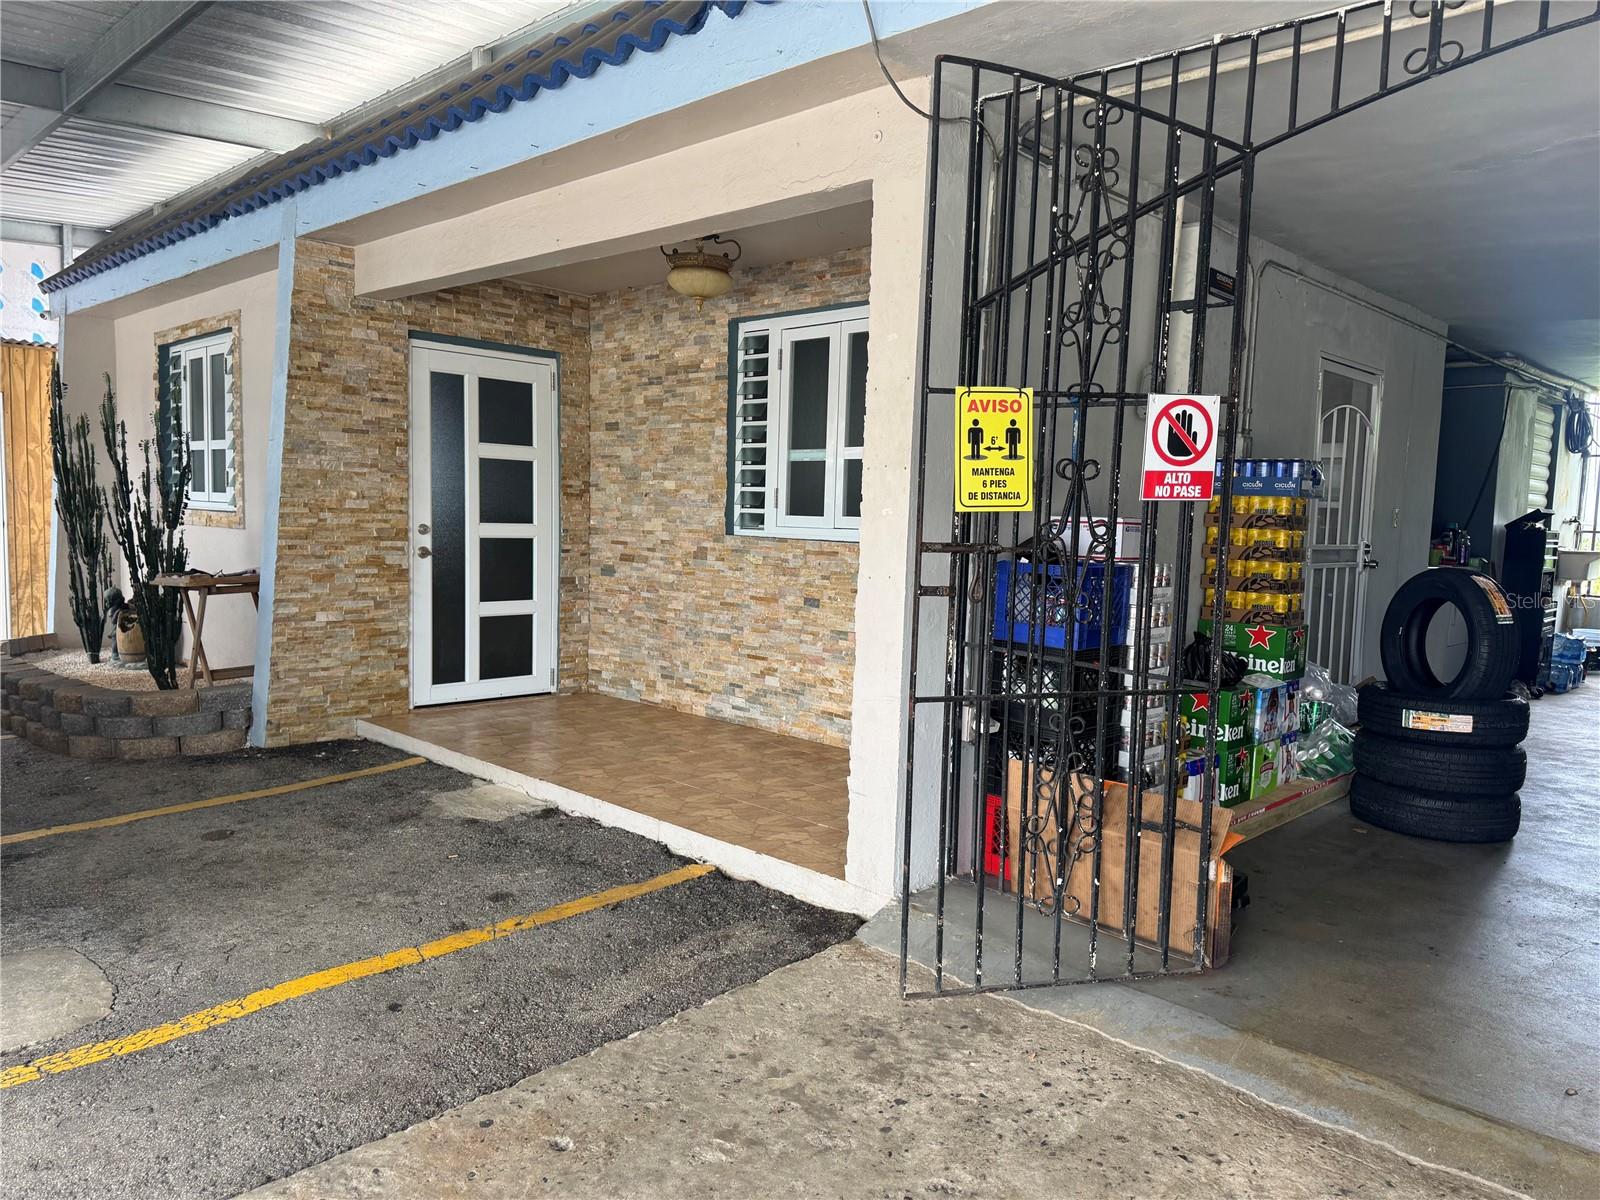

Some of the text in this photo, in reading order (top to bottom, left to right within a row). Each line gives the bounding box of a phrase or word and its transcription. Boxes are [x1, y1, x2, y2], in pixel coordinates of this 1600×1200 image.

[967, 399, 1023, 414] AVISO
[971, 467, 1015, 477] MANTENGA
[1164, 472, 1191, 485] ALTO
[982, 479, 1007, 488] 6 PIES
[968, 491, 1021, 501] DE DISTANCIA
[1154, 485, 1202, 498] NO PASE
[1224, 624, 1234, 632] 24
[1223, 650, 1296, 675] ineken
[1185, 718, 1244, 742] eineken
